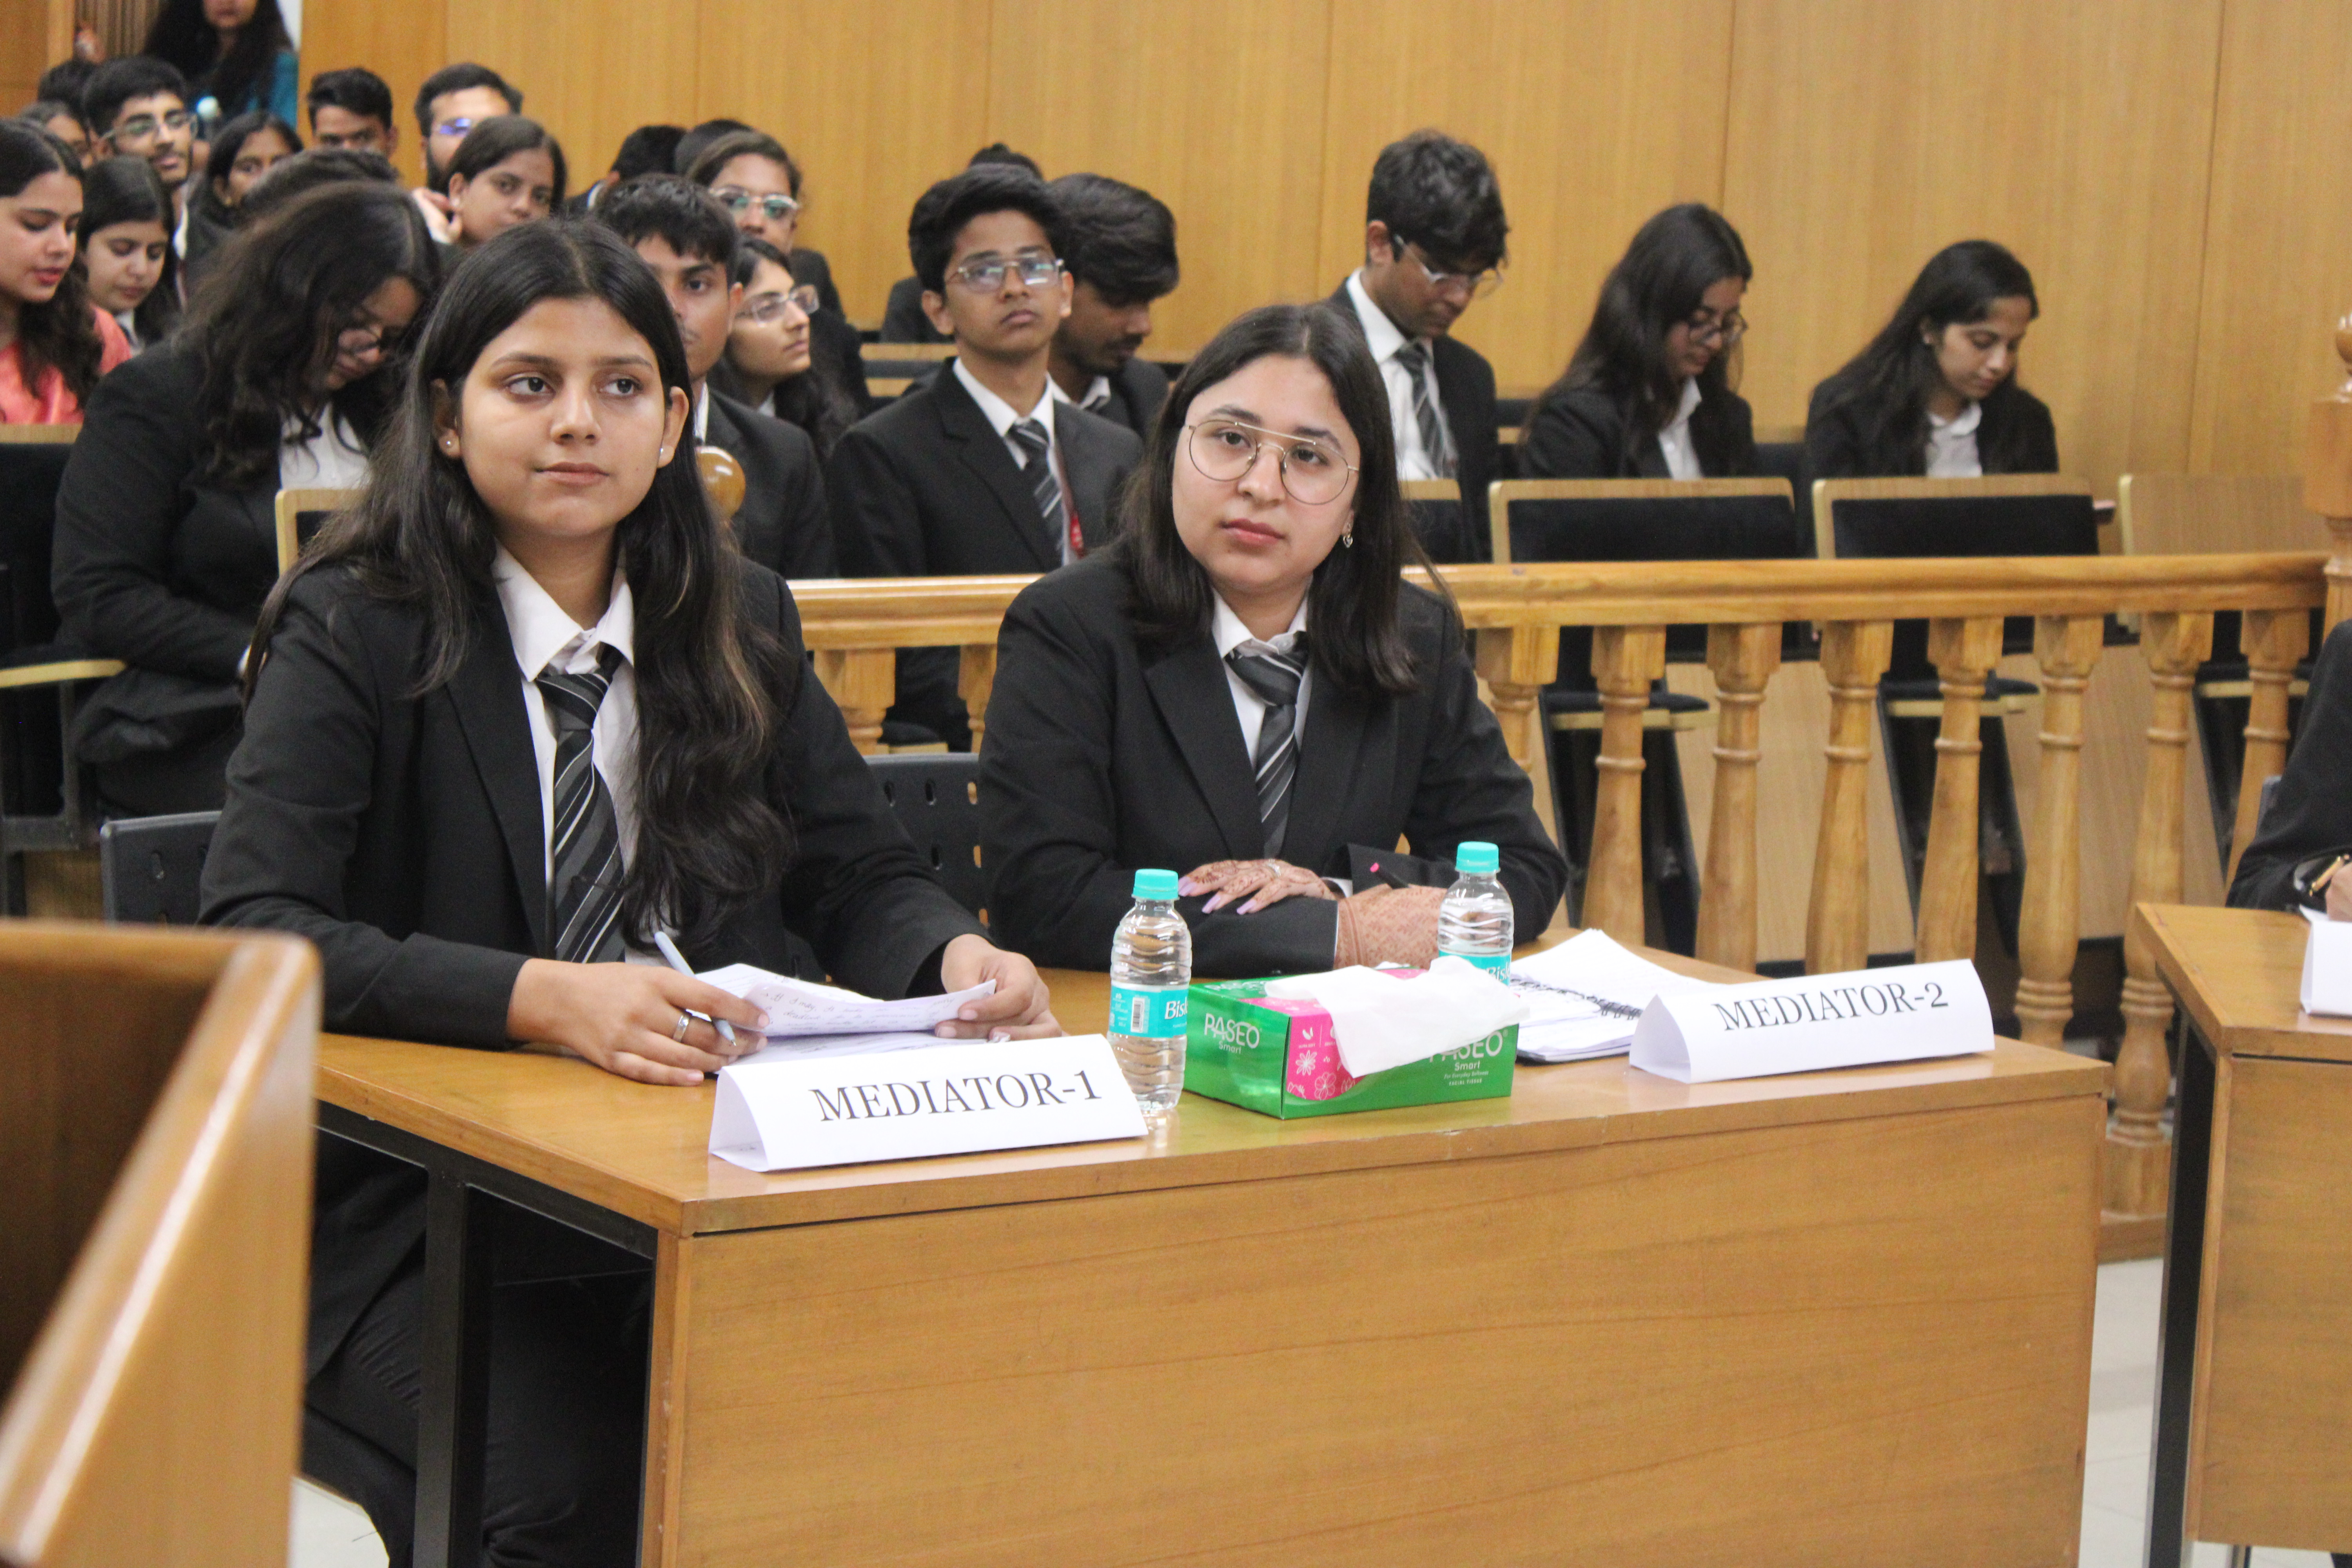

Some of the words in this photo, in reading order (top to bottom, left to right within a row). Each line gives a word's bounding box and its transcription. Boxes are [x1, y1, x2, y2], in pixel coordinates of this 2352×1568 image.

[1712, 982, 1949, 1031] MEDIATOR-2
[1204, 1013, 1259, 1049] PASEO
[1219, 1040, 1241, 1054] Smart
[1429, 1031, 1503, 1063] SEO
[1454, 1060, 1481, 1071] Smart
[808, 1070, 1102, 1121] MEDIATOR-1
